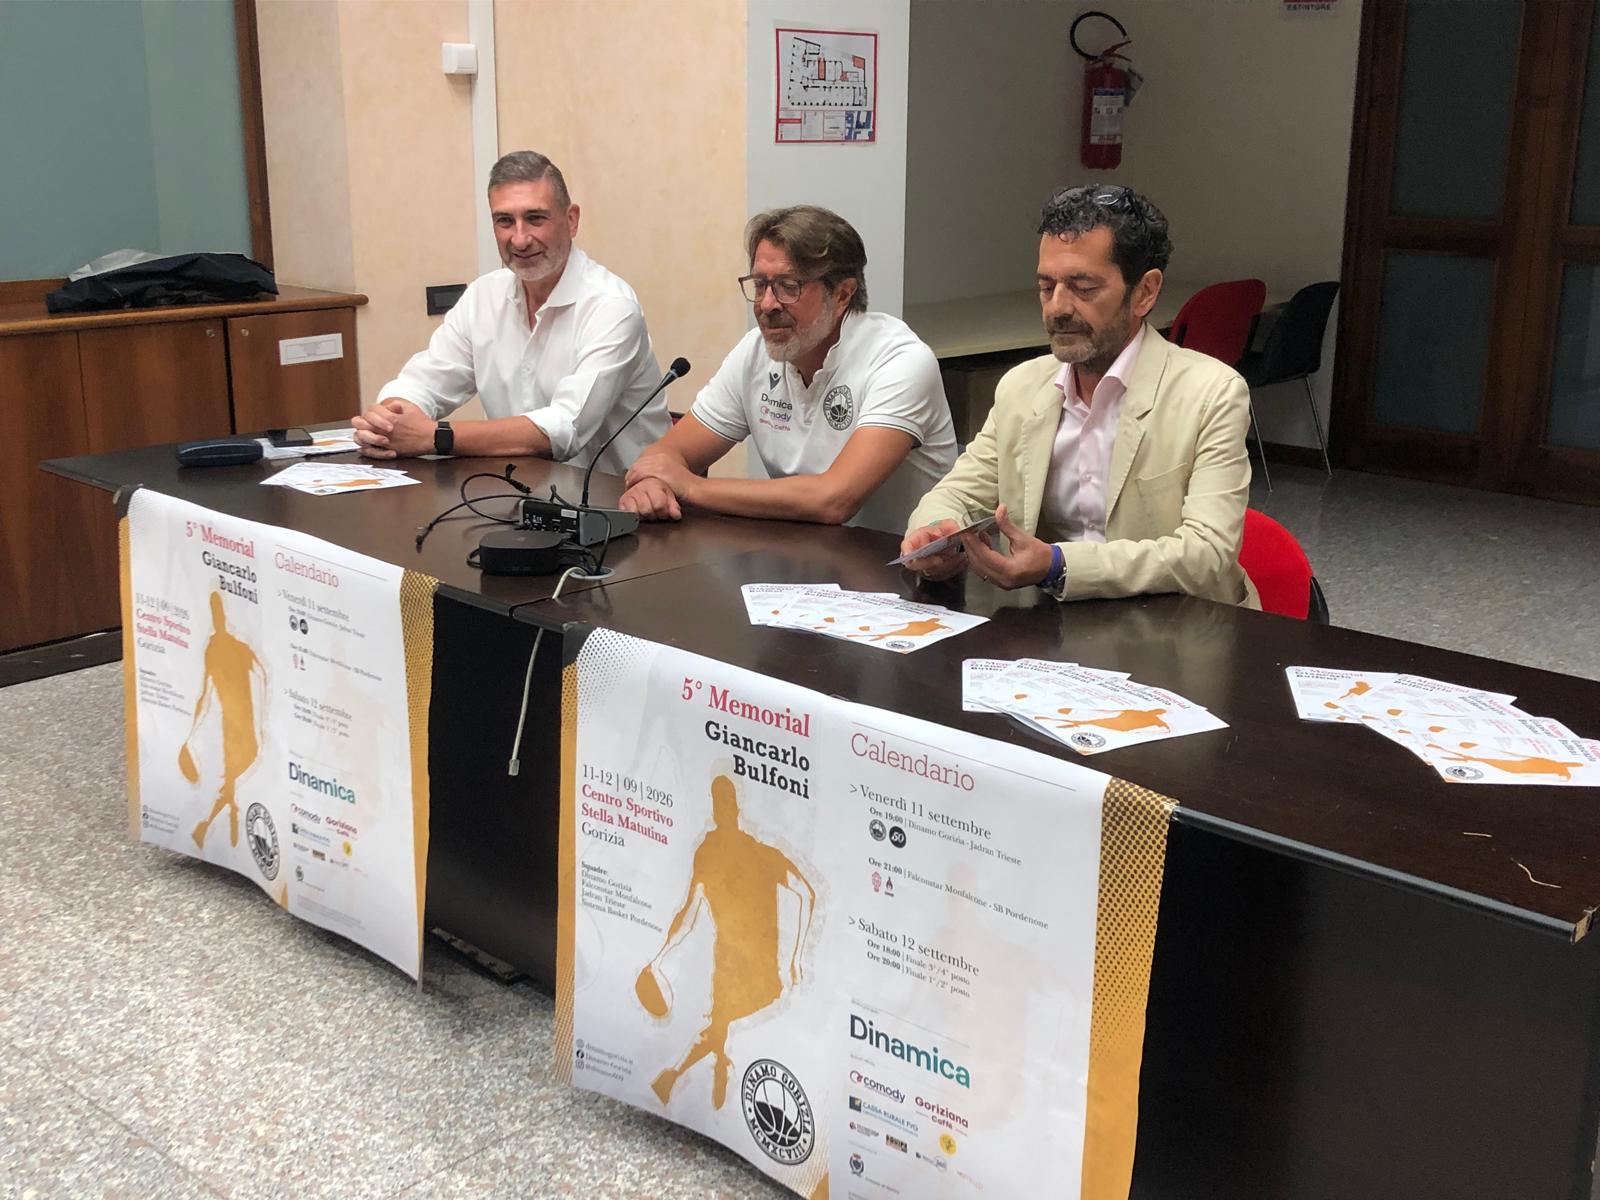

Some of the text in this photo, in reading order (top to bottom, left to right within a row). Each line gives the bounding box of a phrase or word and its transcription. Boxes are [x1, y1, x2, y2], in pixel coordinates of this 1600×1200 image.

[201, 524, 255, 559] Memorial
[202, 550, 258, 584] Giancarlo
[218, 575, 259, 605] Bulfoni
[274, 551, 340, 588] Calendario
[681, 676, 811, 738] 5° Memorial
[704, 719, 811, 772] Giancarlo
[850, 732, 976, 792] Calendario
[288, 761, 356, 805] Dinamica
[582, 764, 613, 786] 11-12
[623, 776, 638, 794] 09
[646, 789, 674, 808] 2026
[733, 754, 810, 799] Bulfoni
[581, 784, 674, 828] Centro Sportivo
[581, 803, 669, 846] Stella Matutina
[859, 784, 992, 841] Venerdì 11 settembre
[581, 822, 625, 848] Gorizia
[869, 806, 882, 818] Ore
[907, 819, 937, 837] Dinamo
[938, 829, 965, 847] Gorizia
[970, 839, 994, 856] Jadran
[996, 849, 1022, 867] Trieste
[868, 856, 882, 868] Ore
[883, 861, 903, 876] 21:00
[907, 870, 943, 891] Falconstar
[944, 883, 987, 909] Monfalcone
[992, 902, 1004, 914] SB
[1005, 906, 1049, 930] Pordenone
[858, 917, 980, 977] Sabato 12 settembre
[867, 938, 881, 951] Ore
[906, 953, 927, 970] Finale
[951, 971, 970, 986] posto
[867, 951, 881, 963] Ore
[882, 957, 901, 971] 20:00
[906, 965, 927, 981] Finale
[951, 984, 970, 999] posto
[850, 1013, 971, 1089] Dinamica
[745, 1064, 811, 1135] DINAMO GORIZIA
[863, 1076, 969, 1129] comody Goriziana
